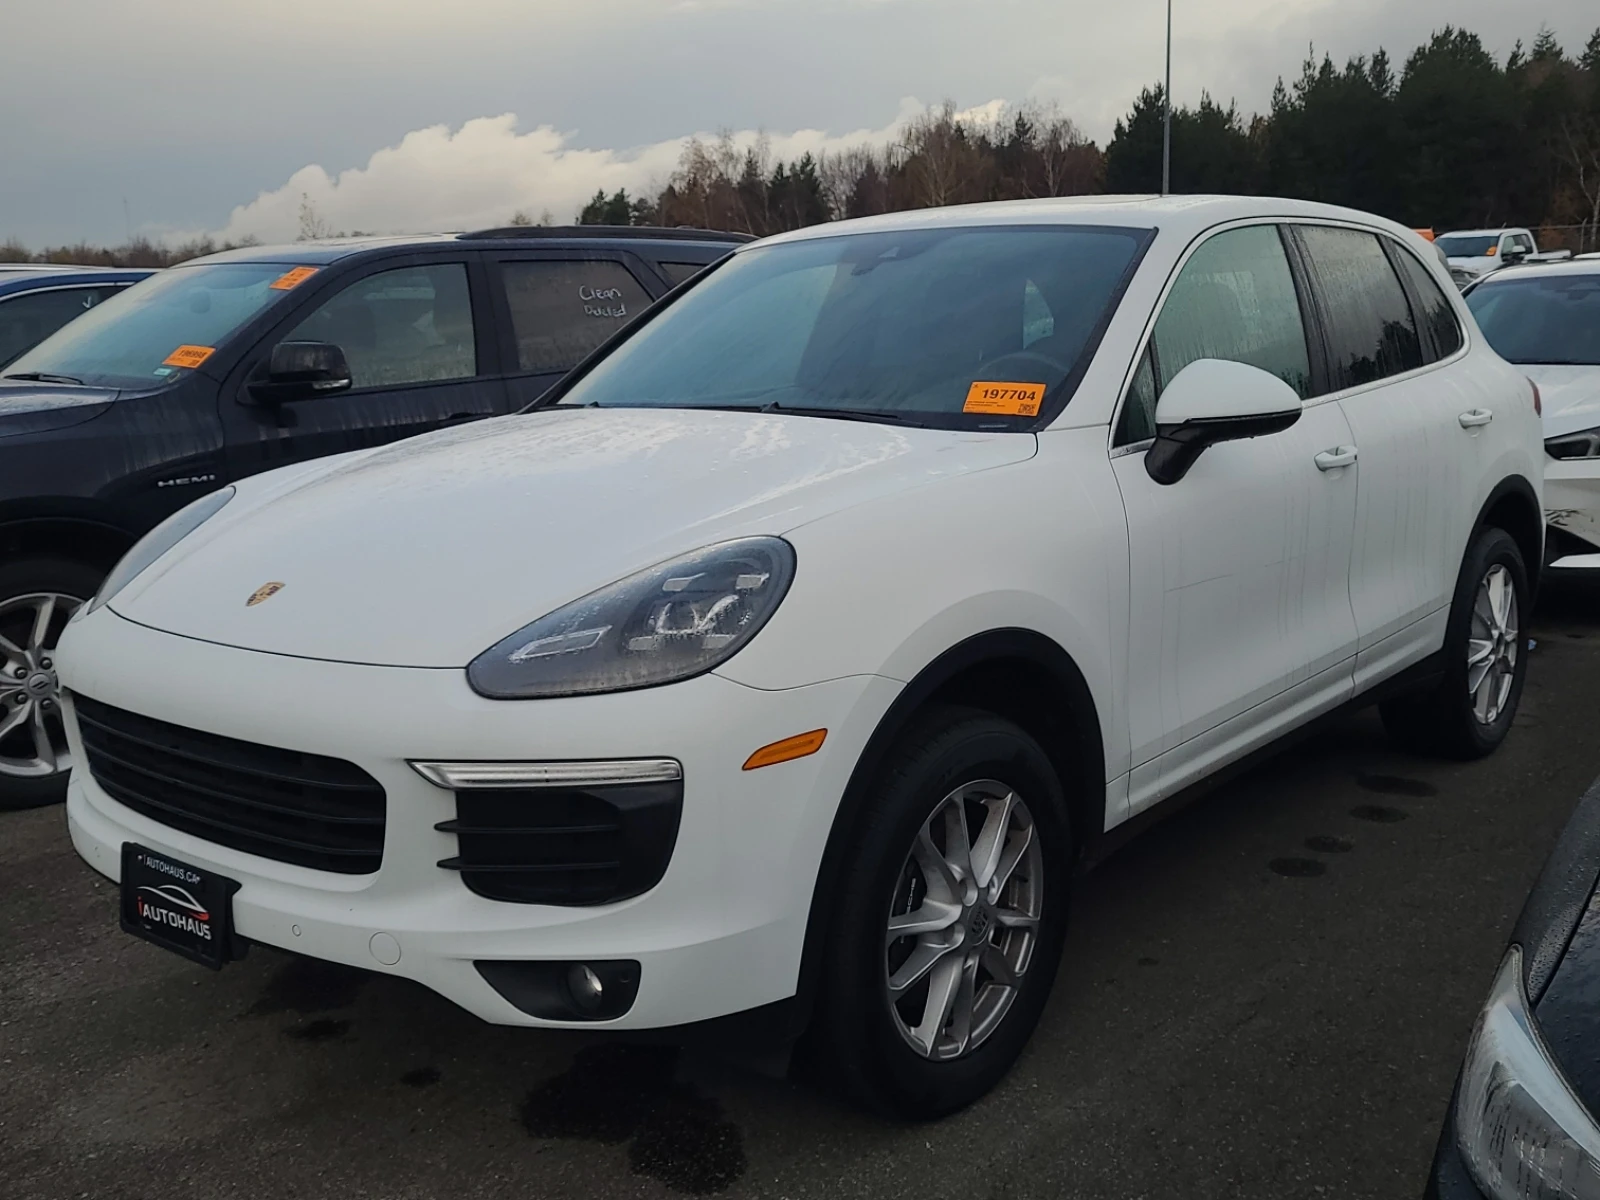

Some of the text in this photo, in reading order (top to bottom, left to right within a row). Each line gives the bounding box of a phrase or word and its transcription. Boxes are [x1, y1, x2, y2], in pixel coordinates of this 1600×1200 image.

[579, 285, 621, 300] Clean
[981, 388, 1036, 401] 197704
[158, 474, 215, 488] HEMI
